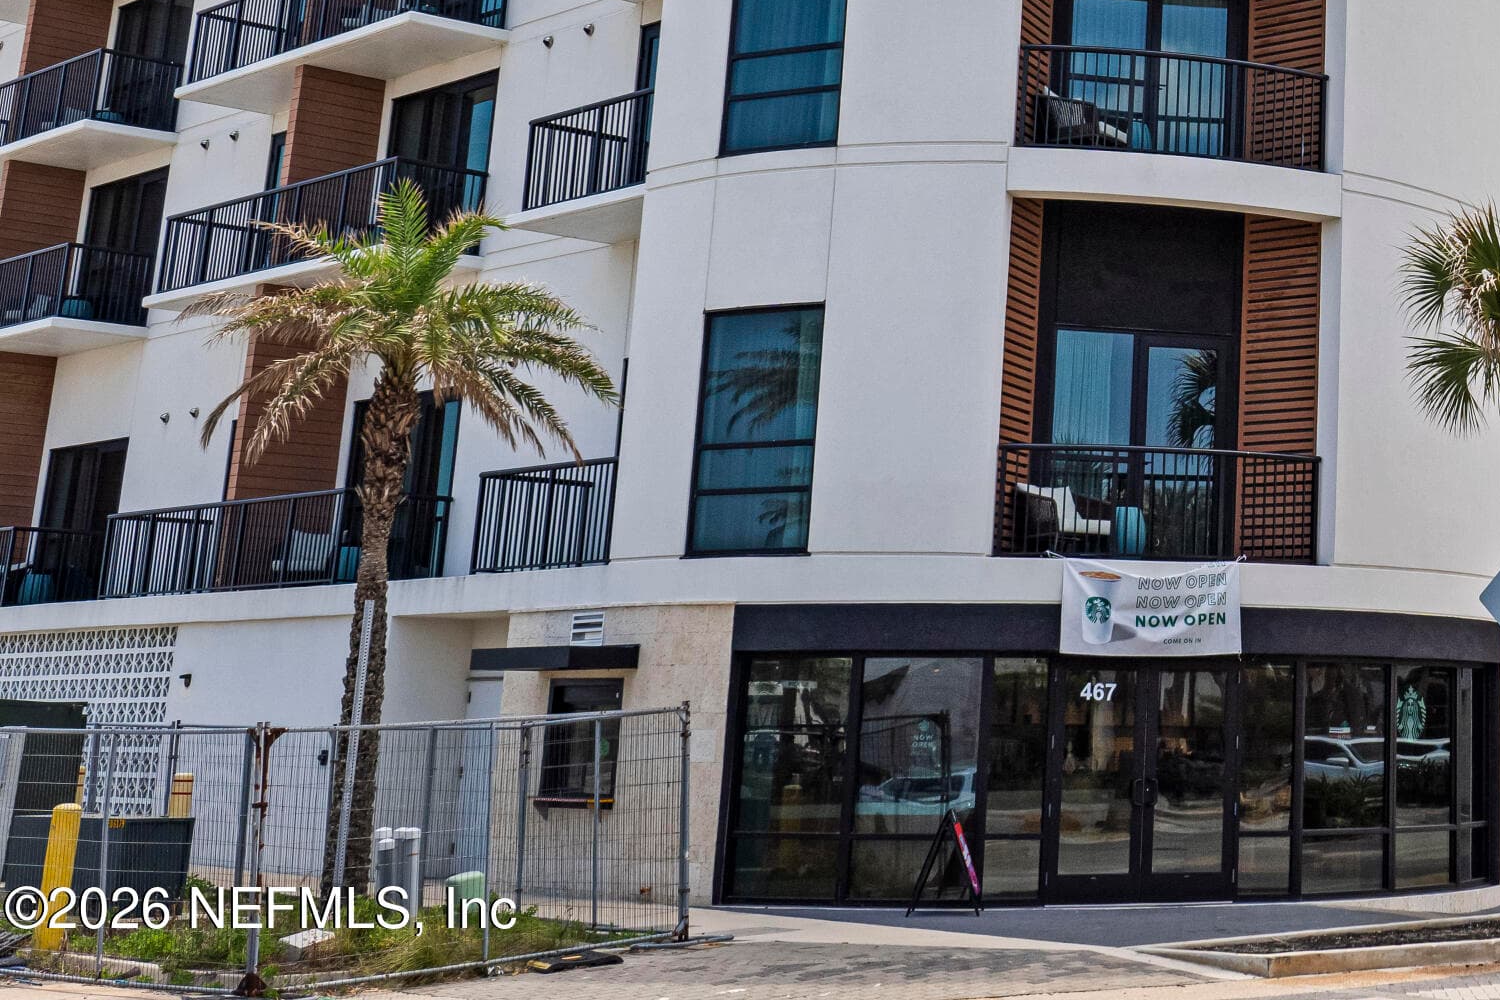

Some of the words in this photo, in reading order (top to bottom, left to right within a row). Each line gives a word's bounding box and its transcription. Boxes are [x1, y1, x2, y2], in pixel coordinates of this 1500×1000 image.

[1138, 576, 1182, 590] NOW
[1186, 573, 1227, 589] OPEN
[1136, 595, 1181, 609] NOW
[1184, 591, 1227, 608] OPEN
[1135, 615, 1178, 627] NOW
[1184, 612, 1226, 626] OPEN
[1080, 682, 1117, 701] 467
